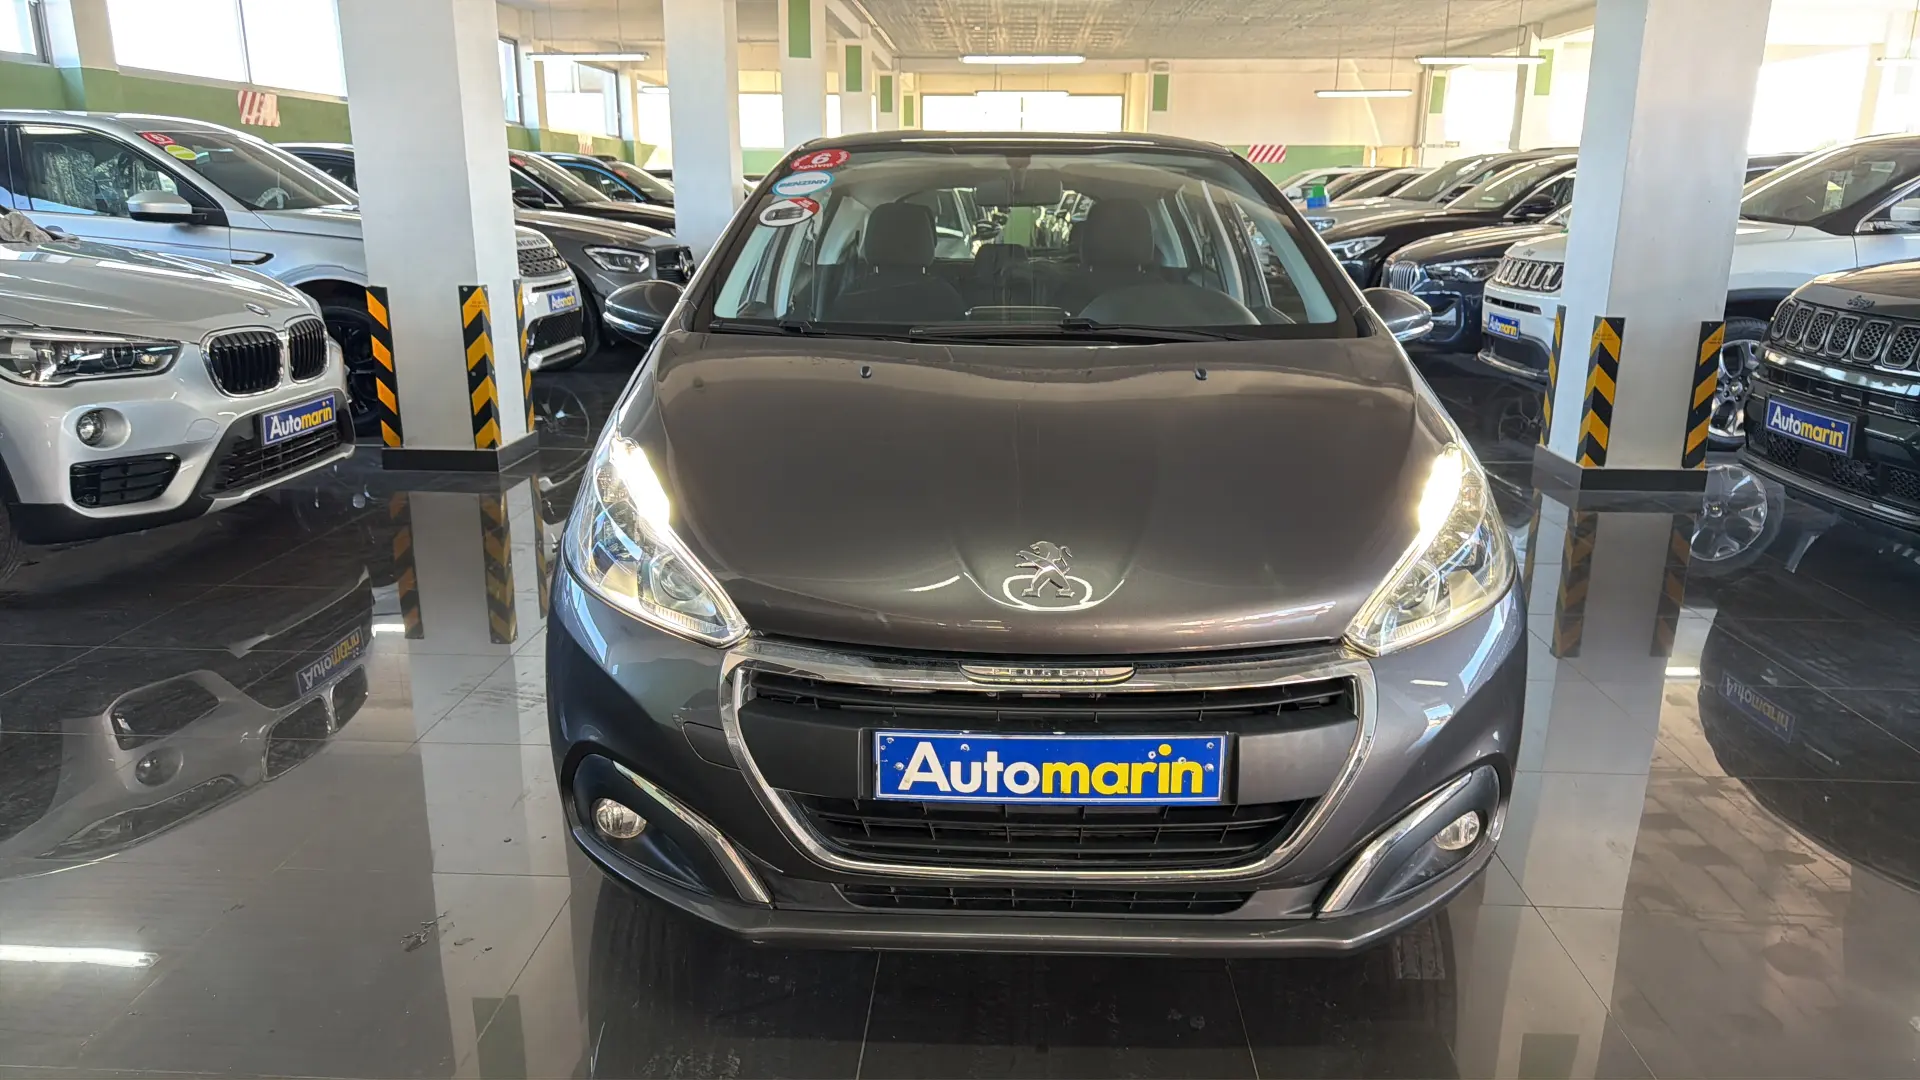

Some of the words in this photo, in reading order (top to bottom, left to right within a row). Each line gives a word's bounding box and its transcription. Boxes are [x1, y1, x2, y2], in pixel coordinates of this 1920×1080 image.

[811, 152, 832, 165] 6
[269, 400, 333, 440] Automarin
[1770, 405, 1844, 448] Automarin
[897, 741, 1204, 795] Automarin
